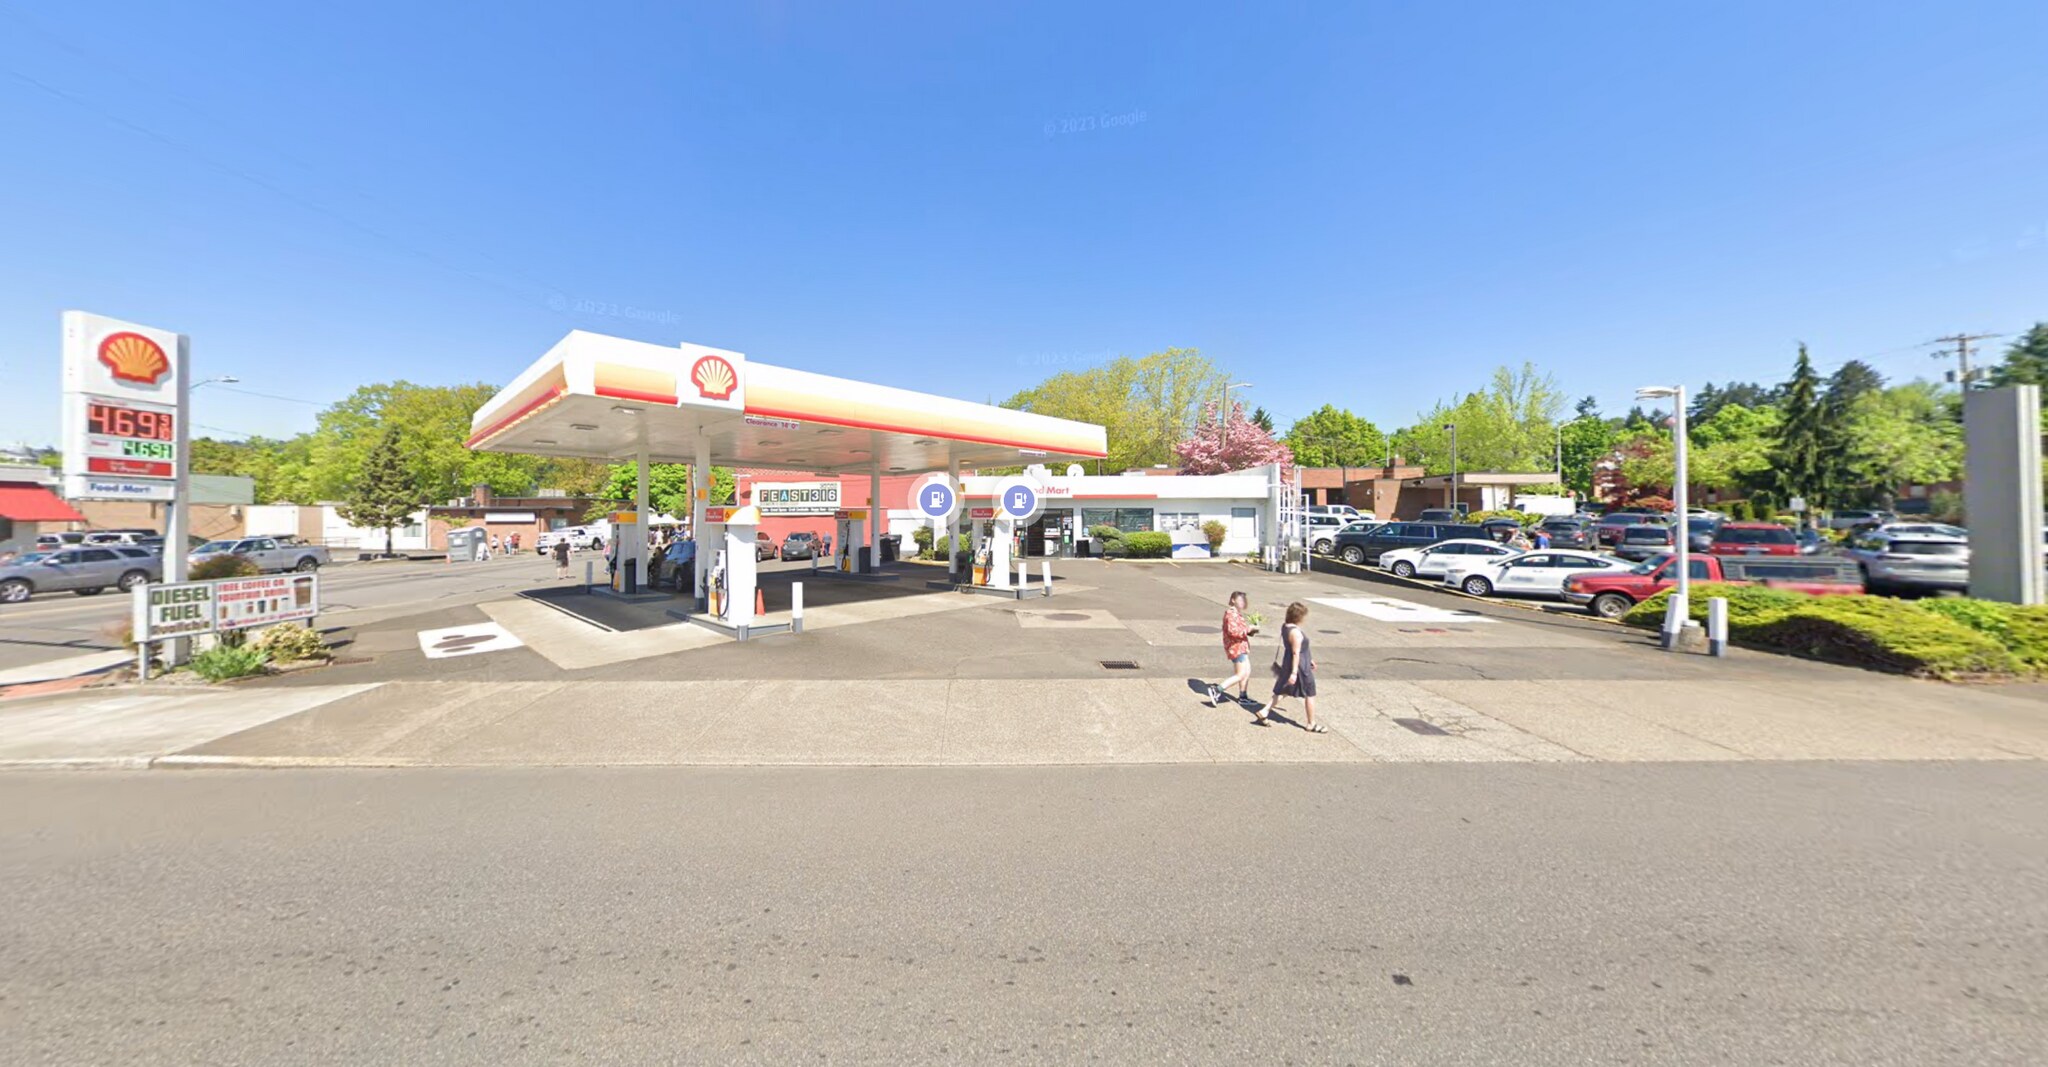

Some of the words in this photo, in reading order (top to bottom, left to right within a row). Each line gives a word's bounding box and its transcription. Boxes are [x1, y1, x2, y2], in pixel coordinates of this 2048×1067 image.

[745, 418, 778, 427] Clearance
[90, 483, 119, 492] Food
[122, 484, 151, 493] Mart
[1046, 486, 1069, 494] Mart
[760, 489, 837, 502] FEAST316
[242, 580, 271, 589] COFFEE
[152, 587, 210, 604] DIESEL
[161, 605, 202, 621] FUEL
